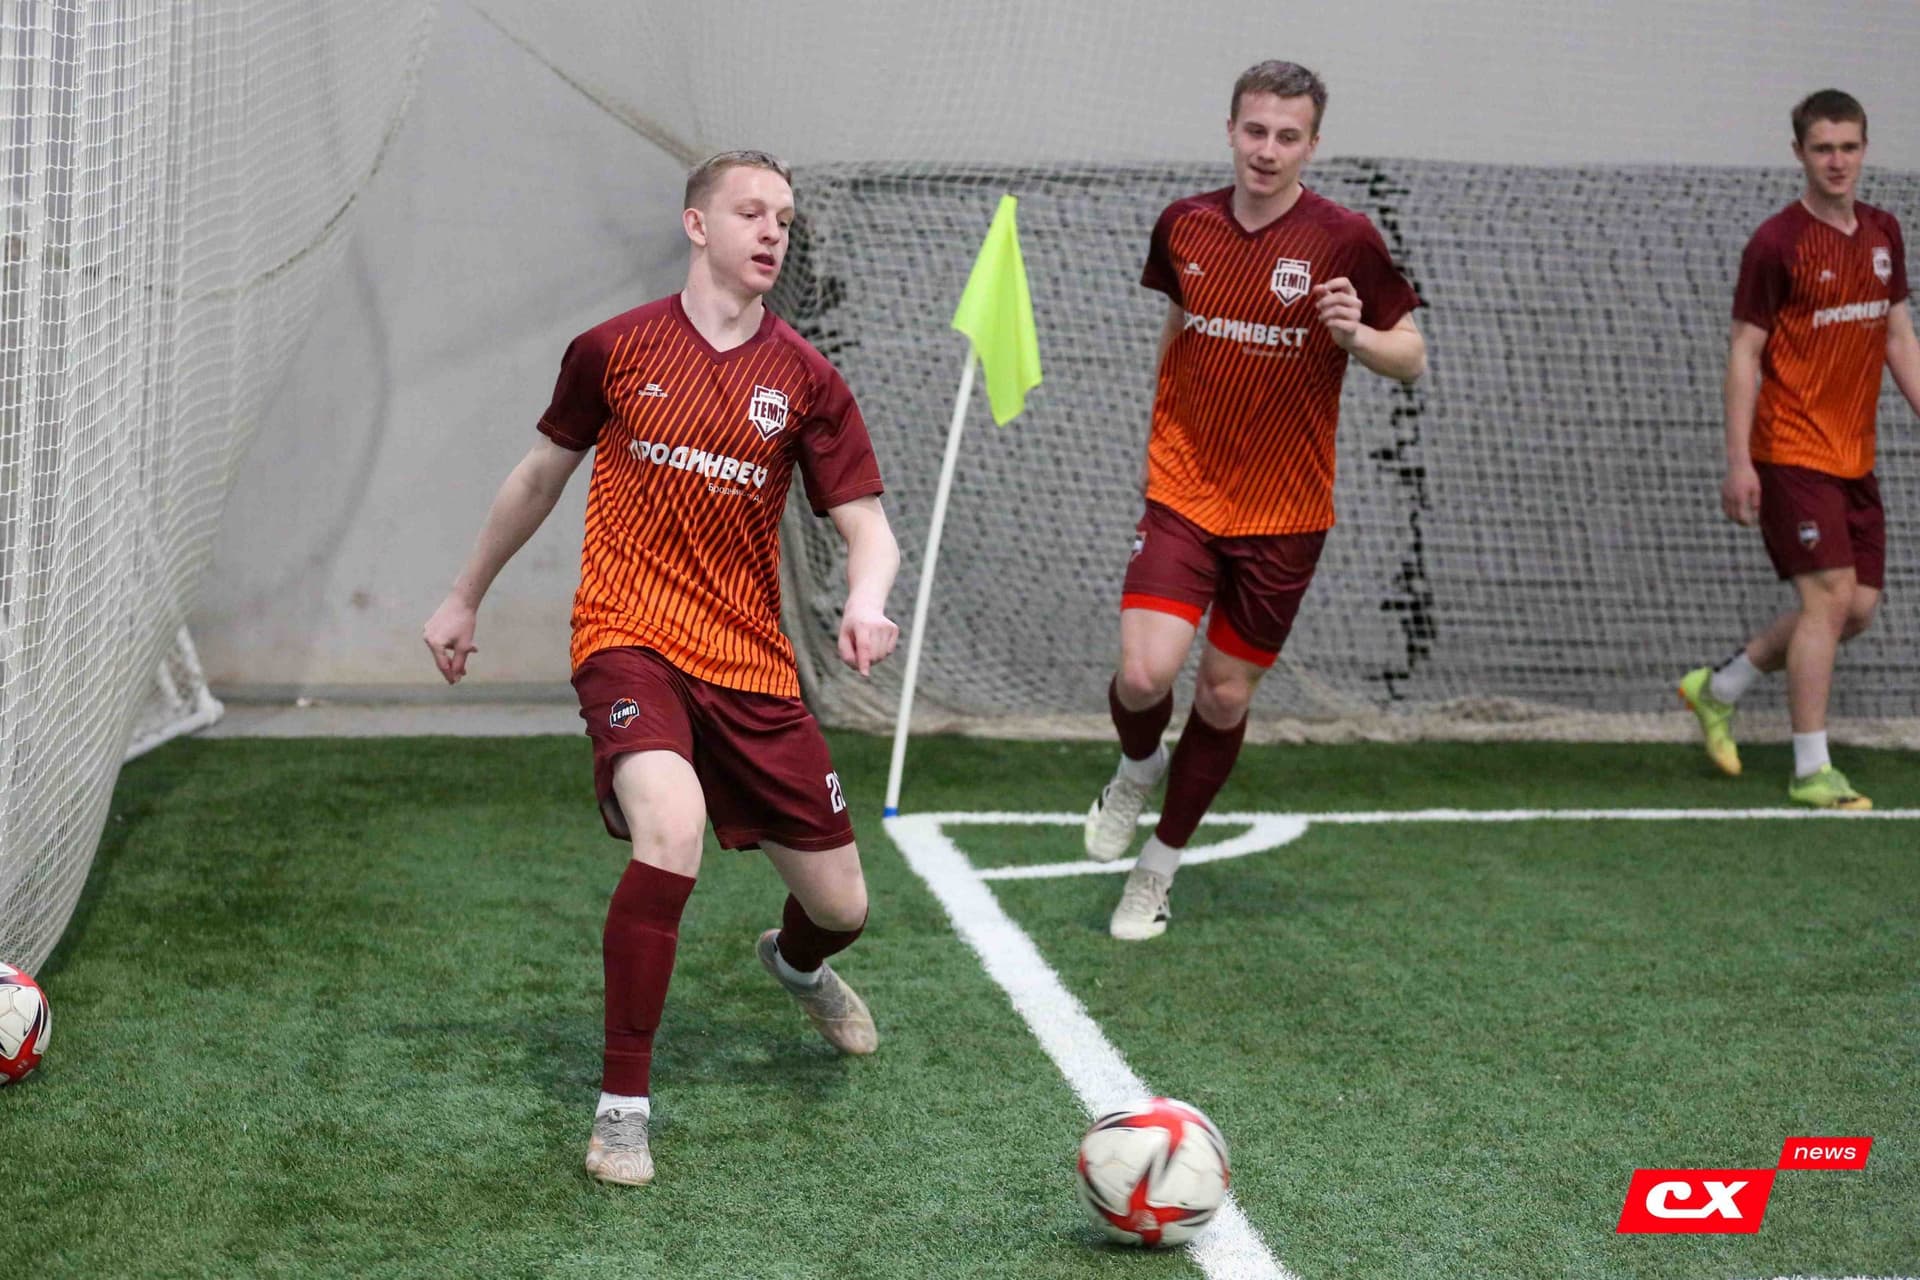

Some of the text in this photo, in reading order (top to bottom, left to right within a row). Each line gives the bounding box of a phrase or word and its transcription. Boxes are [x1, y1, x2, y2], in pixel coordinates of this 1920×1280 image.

[1275, 271, 1308, 293] ТЕМП
[1183, 310, 1309, 348] РОДИНВЕСТ
[753, 400, 786, 427] ТЕМП
[612, 704, 637, 723] ТЕМП
[825, 769, 847, 814] 2
